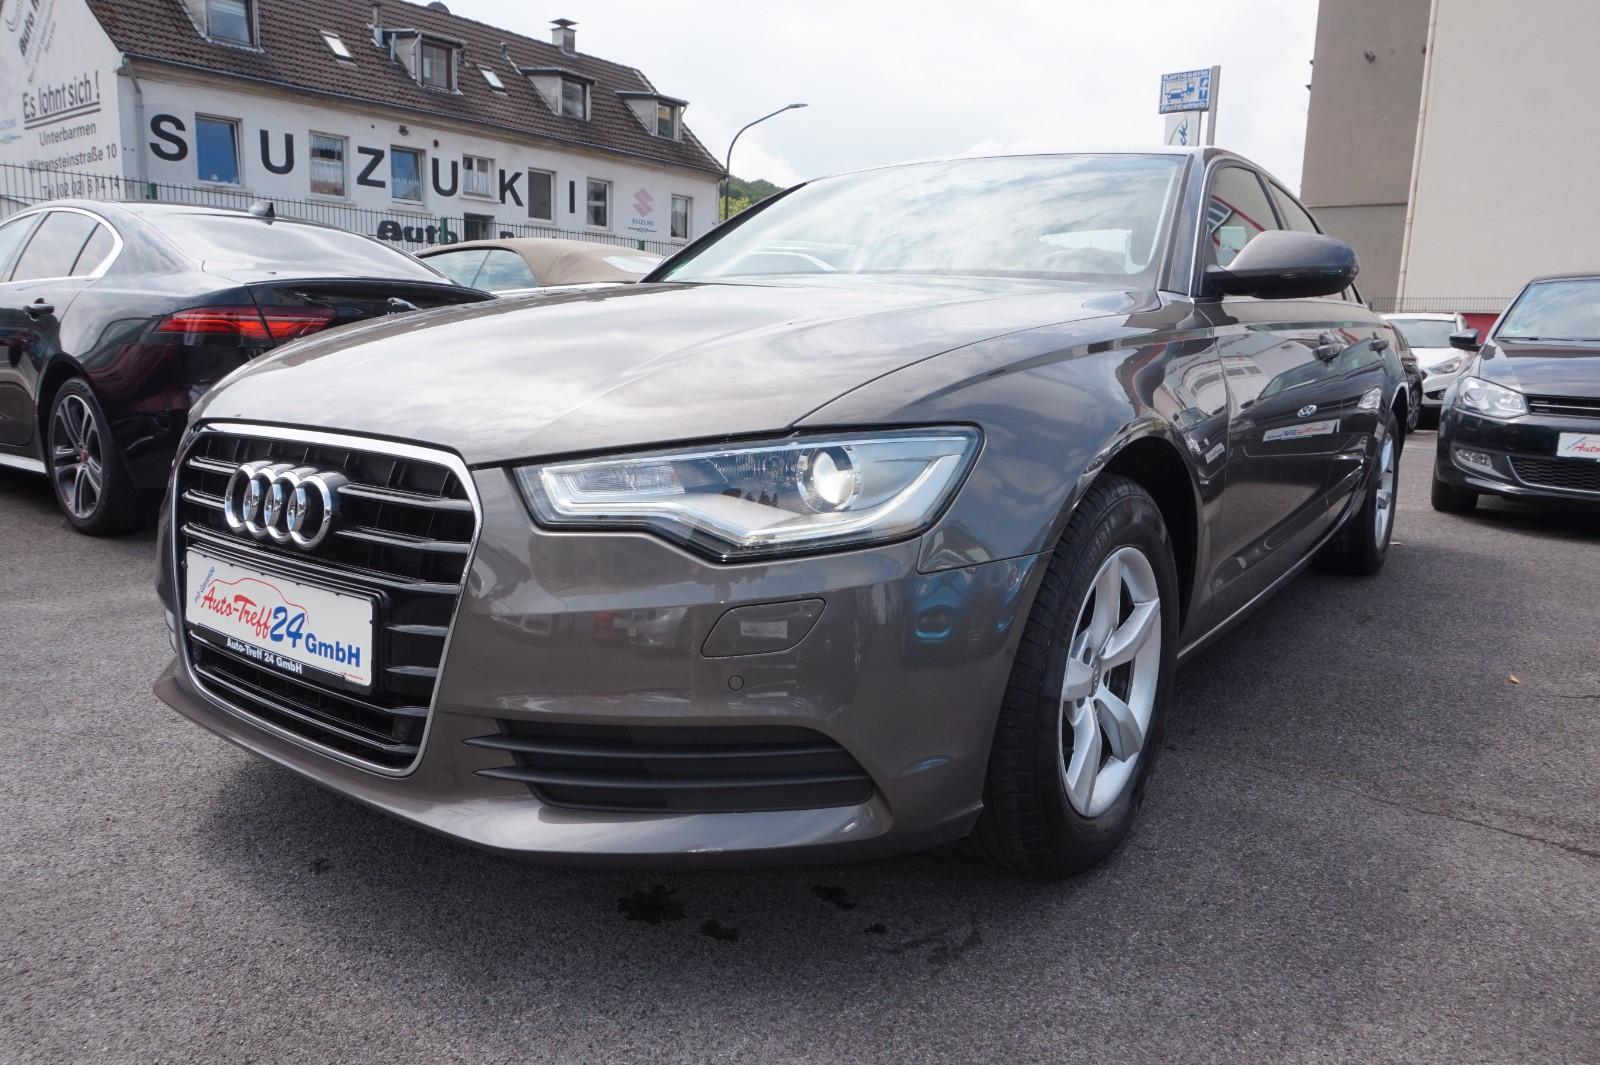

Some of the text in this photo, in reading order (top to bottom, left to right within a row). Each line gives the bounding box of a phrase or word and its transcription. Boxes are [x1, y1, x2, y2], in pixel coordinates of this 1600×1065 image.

[23, 92, 36, 119] Es
[38, 83, 66, 115] lohnt
[68, 72, 92, 106] sich
[39, 123, 96, 146] Unterbarmen
[106, 143, 117, 159] 10
[270, 606, 305, 648] 24
[305, 633, 360, 667] GmbH
[226, 638, 303, 674] Auto-Treff 24 GmbH
